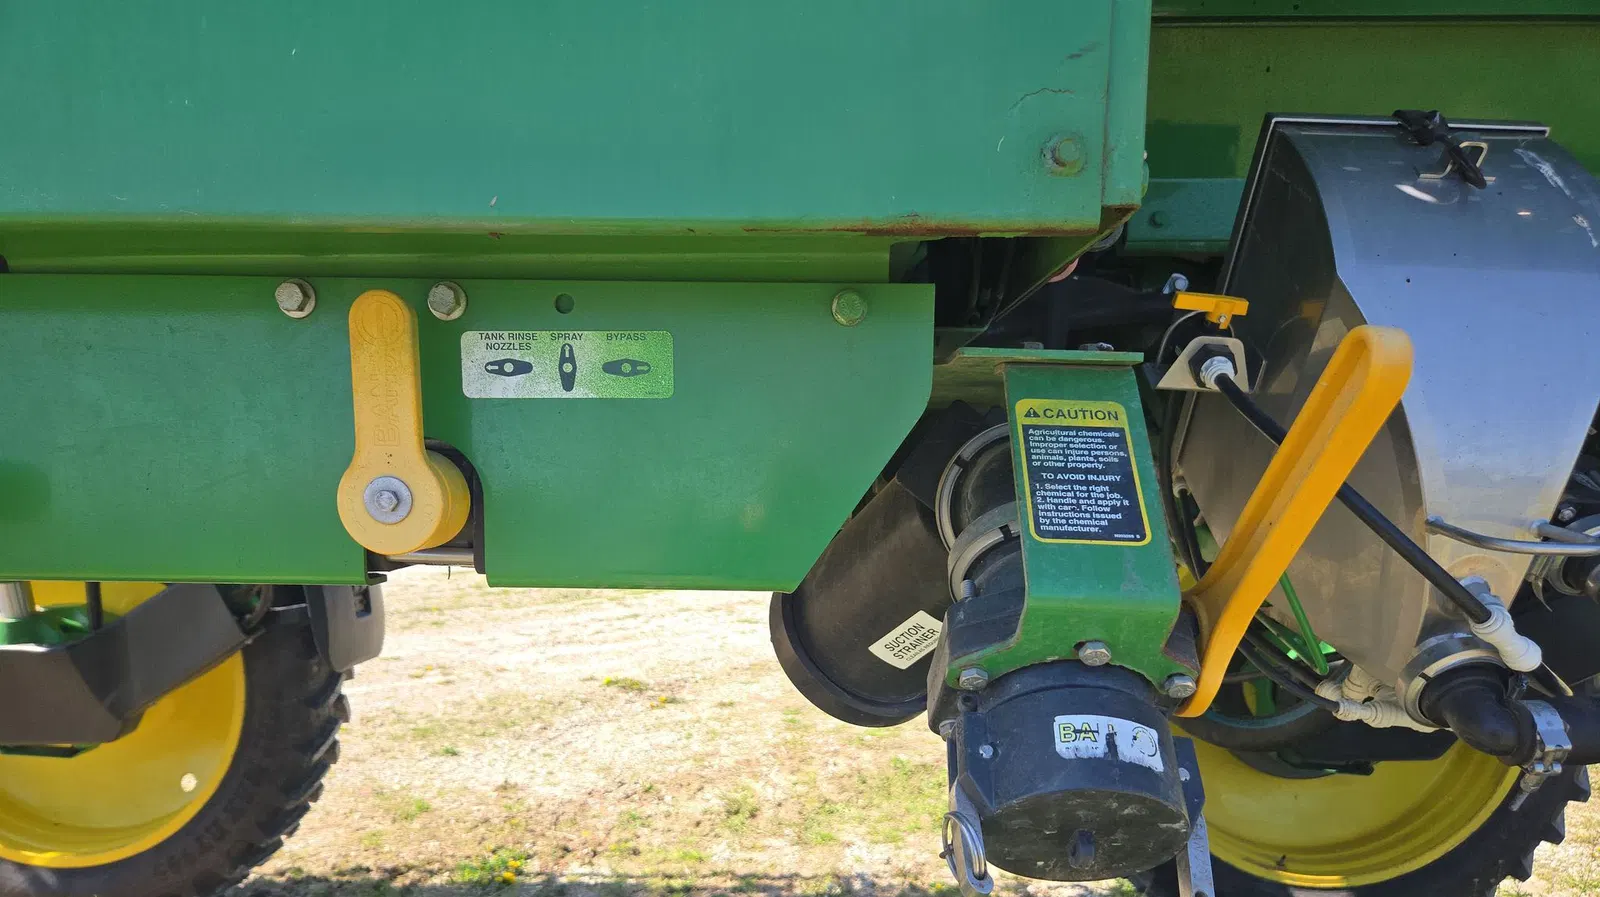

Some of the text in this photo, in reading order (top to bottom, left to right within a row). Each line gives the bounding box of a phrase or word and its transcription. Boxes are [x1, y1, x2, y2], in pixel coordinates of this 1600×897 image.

[479, 333, 538, 341] TANK RINSE
[550, 333, 584, 341] SPRAY
[607, 333, 646, 341] BYPASS
[1043, 408, 1119, 421] CAUTION
[1078, 430, 1120, 438] chemicals
[1058, 436, 1105, 444] dangerous.
[1039, 510, 1091, 518] instructions
[1041, 525, 1102, 533] manufacturer.
[885, 623, 925, 652] SUCTION
[893, 628, 940, 660] STRAINER
